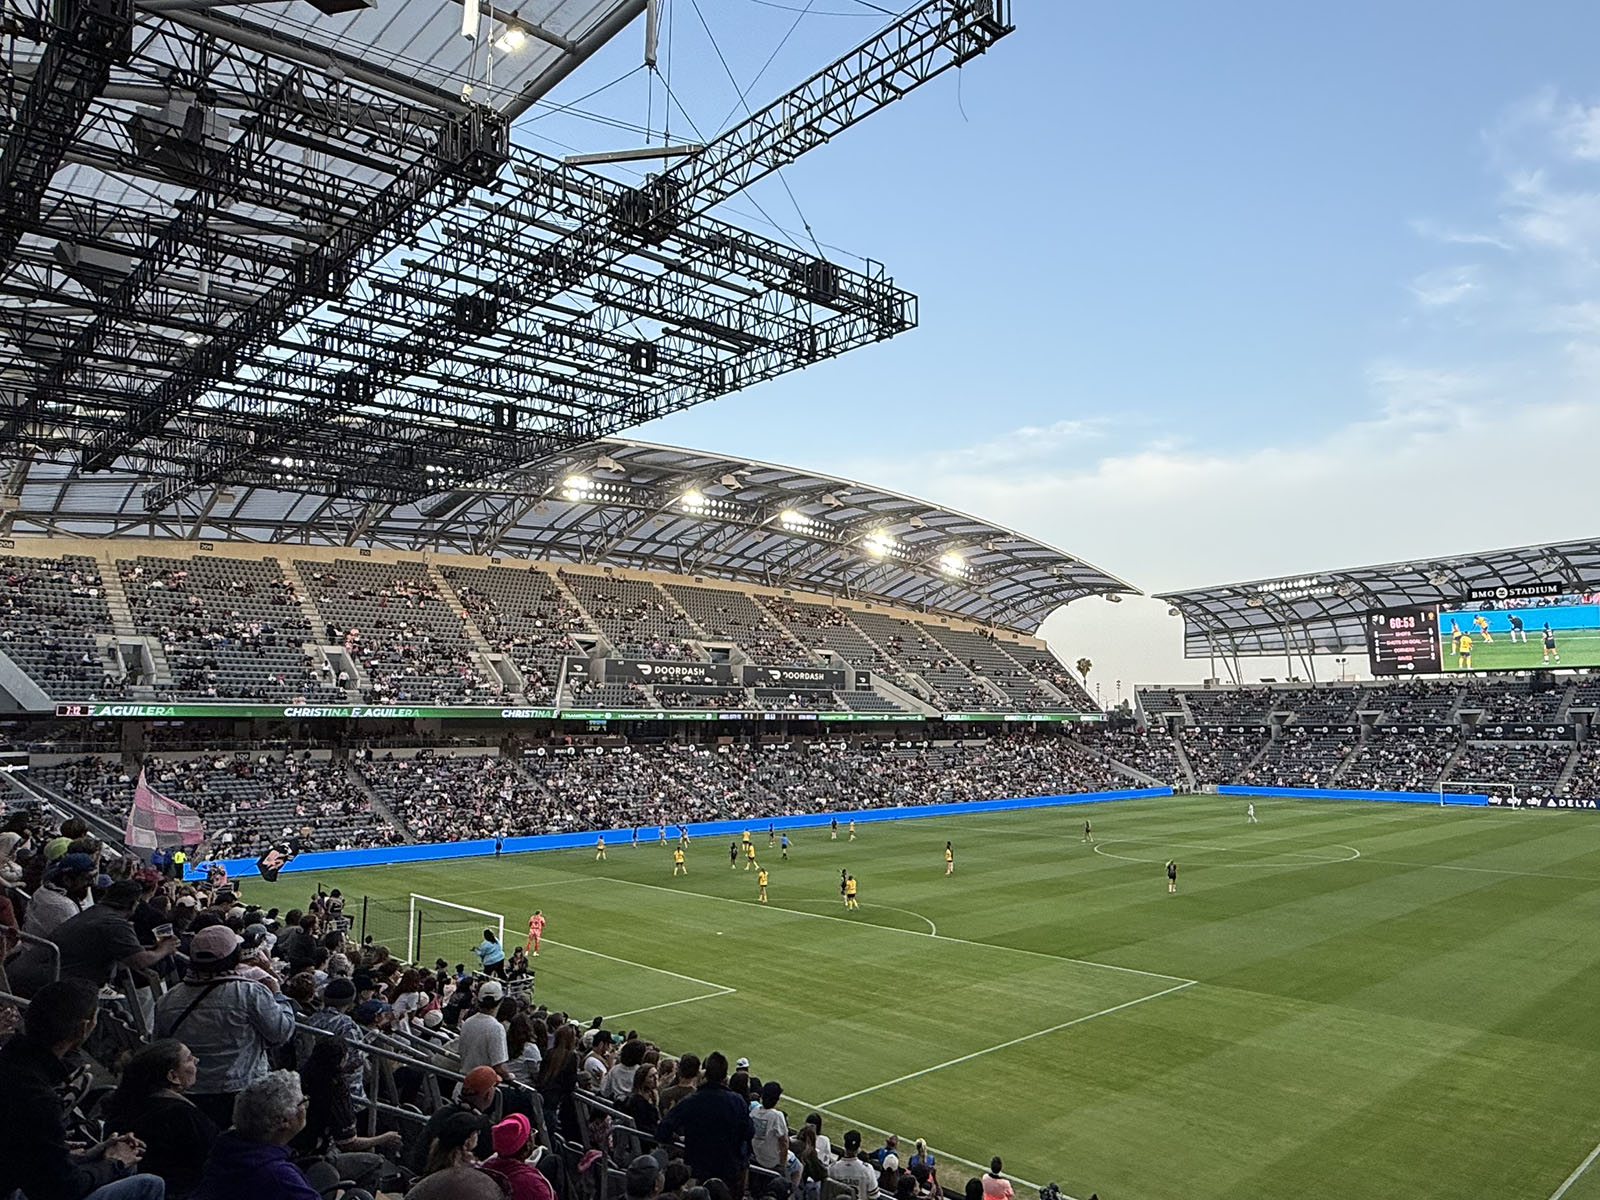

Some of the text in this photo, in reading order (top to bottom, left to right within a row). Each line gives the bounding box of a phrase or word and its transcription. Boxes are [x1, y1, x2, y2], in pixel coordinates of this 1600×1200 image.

[1472, 585, 1558, 599] BMO STADIUM
[1379, 615, 1385, 625] 0
[1421, 612, 1425, 622] 1
[1389, 616, 1415, 629] 60:53
[654, 666, 705, 676] DOORDASH
[783, 671, 825, 680] DOORDASH
[100, 705, 176, 716] AGUILERA
[283, 707, 348, 717] CHRISTINA
[363, 708, 420, 718] AGUILERA
[501, 710, 550, 718] CHRISTINA
[1526, 796, 1542, 806] ally
[1559, 799, 1597, 808] DELTA
